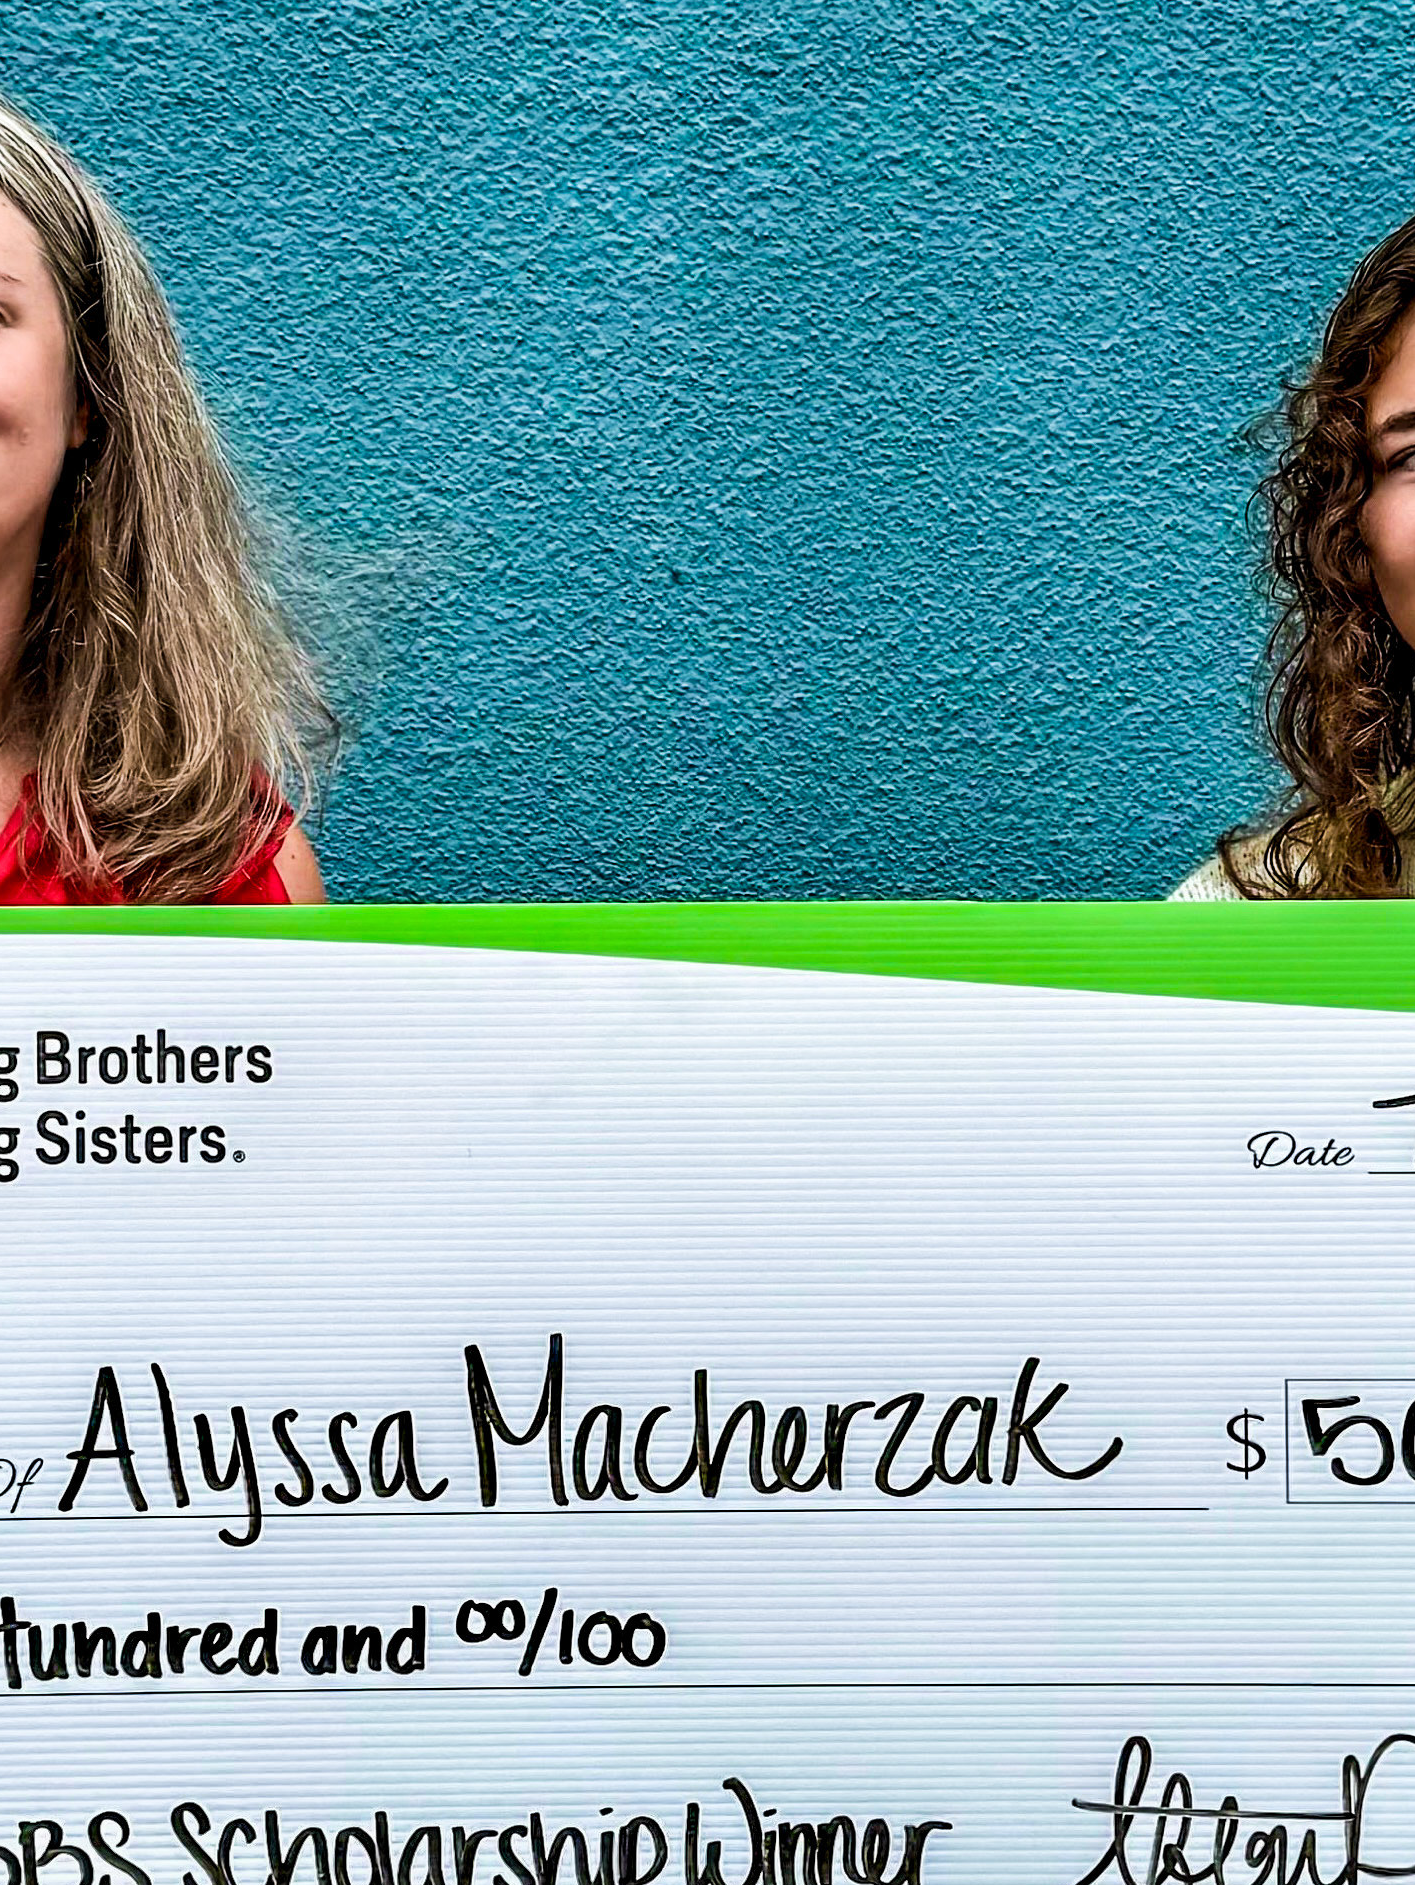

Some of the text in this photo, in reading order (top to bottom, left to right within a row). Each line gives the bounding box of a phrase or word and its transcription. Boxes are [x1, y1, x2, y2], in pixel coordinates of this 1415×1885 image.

[36, 1028, 273, 1085] Brothers
[1246, 1130, 1355, 1169] Date
[58, 1333, 1124, 1547] Alyssa Macherzak
[1226, 1407, 1267, 1480] $
[300, 1604, 426, 1676] and
